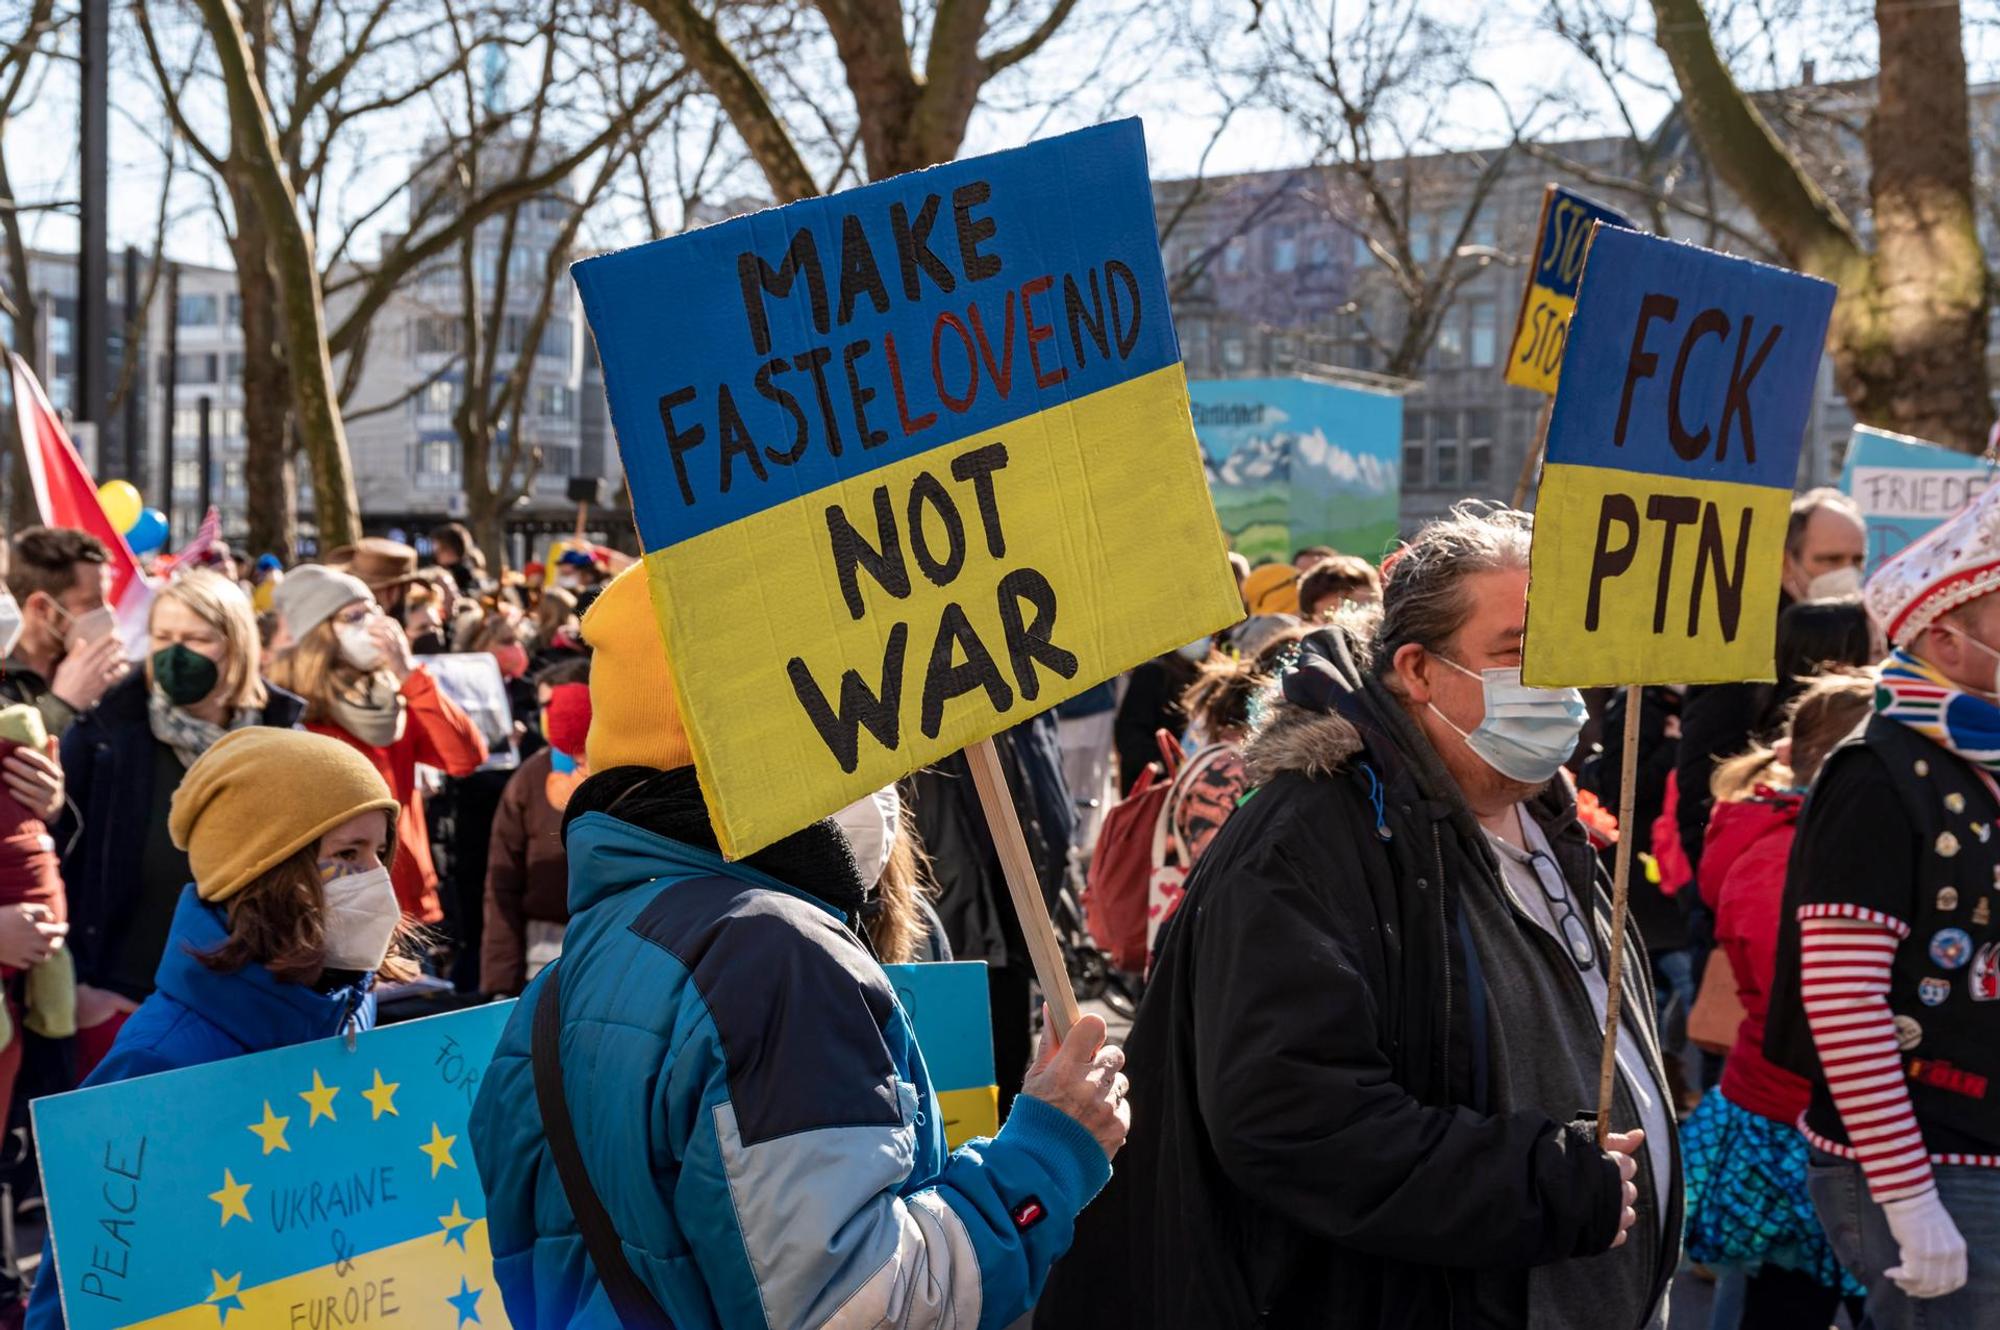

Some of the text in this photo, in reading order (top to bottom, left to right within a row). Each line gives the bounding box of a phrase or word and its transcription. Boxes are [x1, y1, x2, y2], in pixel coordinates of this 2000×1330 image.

[737, 181, 1001, 355] MAKE
[660, 259, 1141, 505] FASTELOVEND
[1613, 293, 1784, 464] FCK
[825, 442, 1009, 620] NOT
[1585, 493, 1754, 644] PTN
[786, 567, 1078, 774] WAR
[434, 1034, 479, 1107] FOR
[81, 1135, 146, 1302] PEACE
[270, 1166, 398, 1234] UKRAINE
[331, 1228, 356, 1278] &
[290, 1277, 401, 1330] EUROPE
